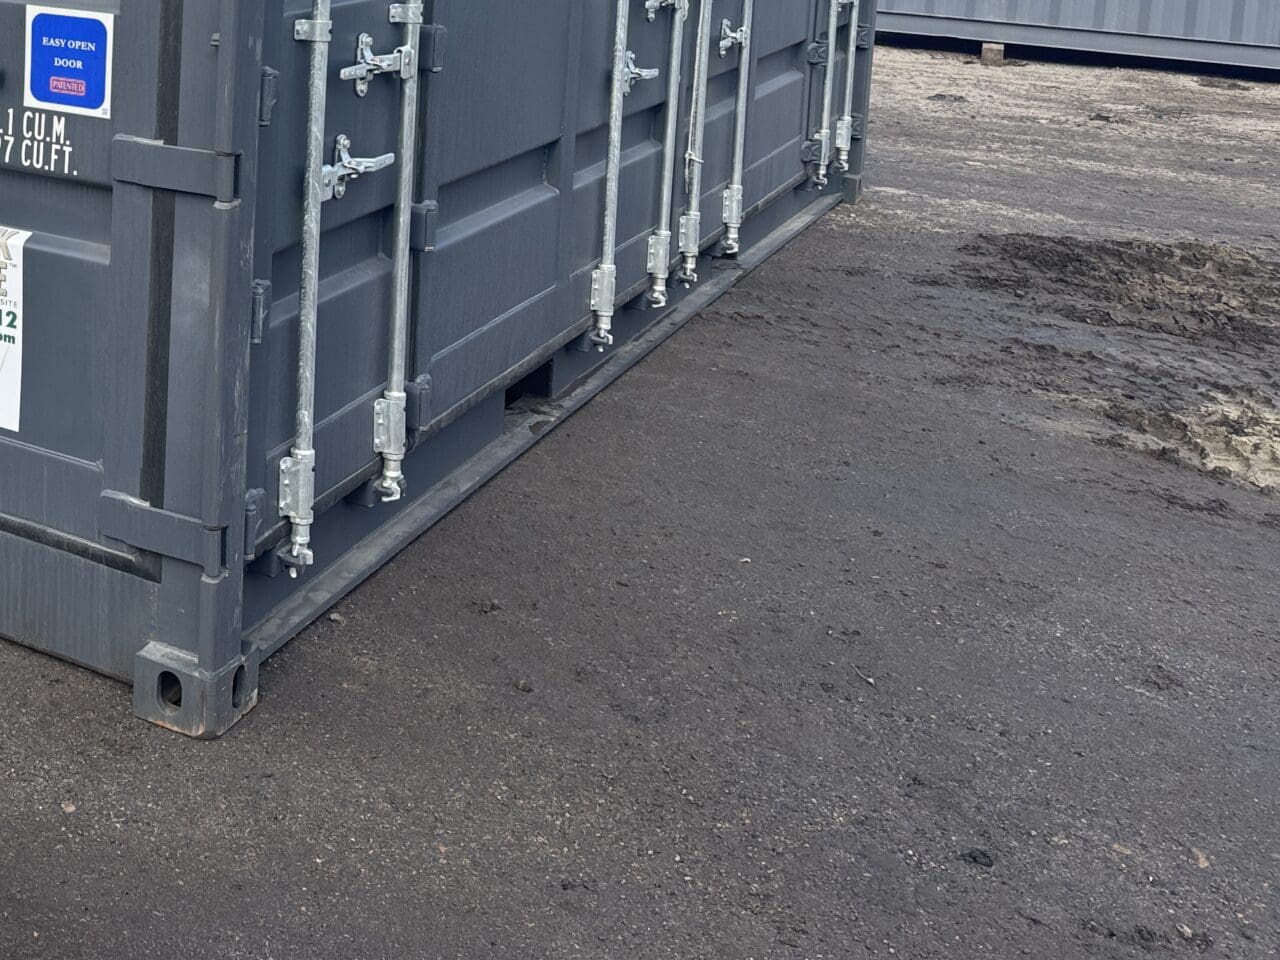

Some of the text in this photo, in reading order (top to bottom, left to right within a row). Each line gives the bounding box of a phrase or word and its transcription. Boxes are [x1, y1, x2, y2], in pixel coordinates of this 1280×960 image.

[42, 37, 96, 52] EASY OPEN
[54, 57, 83, 69] DOOR
[52, 78, 83, 93] PATENTED
[22, 111, 71, 145] CU.M.
[20, 139, 78, 176] CU.FT.
[0, 297, 17, 309] SITE
